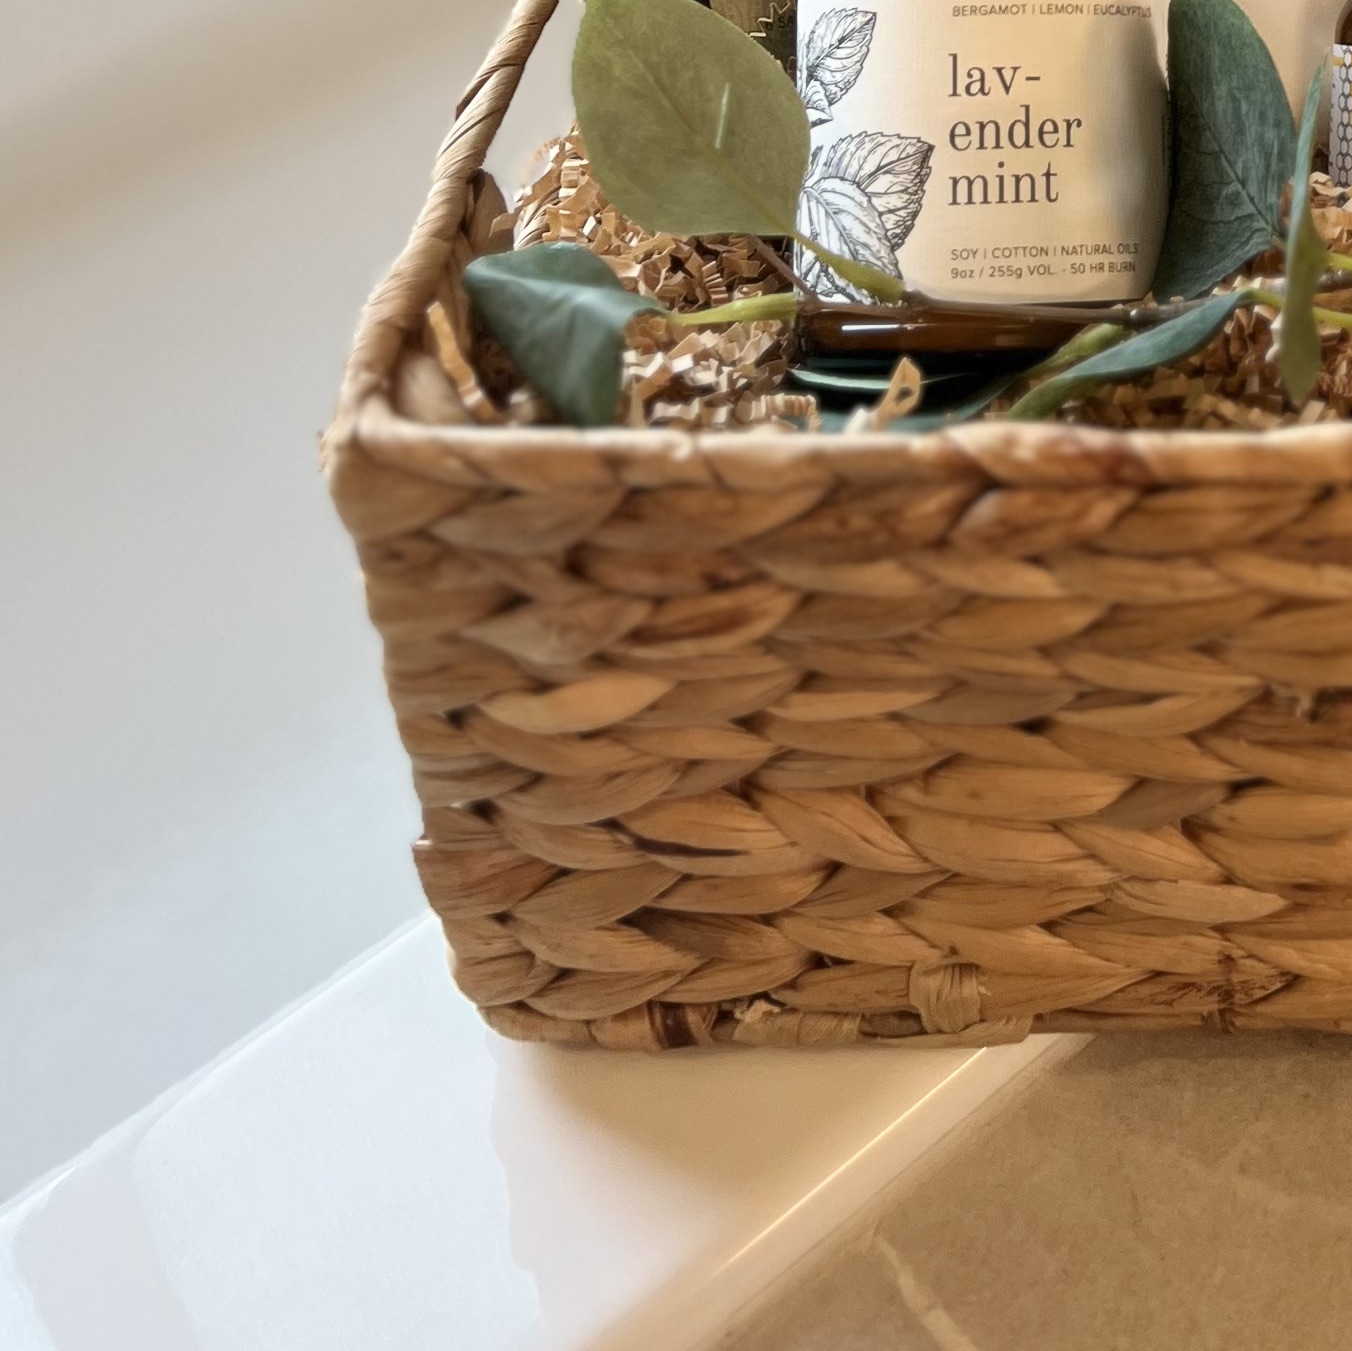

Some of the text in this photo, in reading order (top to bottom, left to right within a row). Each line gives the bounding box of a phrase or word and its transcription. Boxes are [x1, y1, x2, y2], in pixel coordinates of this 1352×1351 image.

[951, 2, 1028, 18] BERGAMOT
[1039, 2, 1084, 15] LEMON
[1093, 3, 1152, 19] EUCALYPTUS
[947, 53, 1042, 98] lav-
[948, 104, 1083, 152] ender
[947, 160, 1060, 207] mint
[950, 248, 979, 261] SOY
[991, 245, 1050, 259] COTTON
[1060, 243, 1114, 257] NATURAL
[950, 267, 975, 280] 9oz
[988, 264, 1024, 280] 255g
[1070, 262, 1087, 275] 50
[1090, 261, 1105, 273] HR
[1108, 260, 1137, 273] BURN
